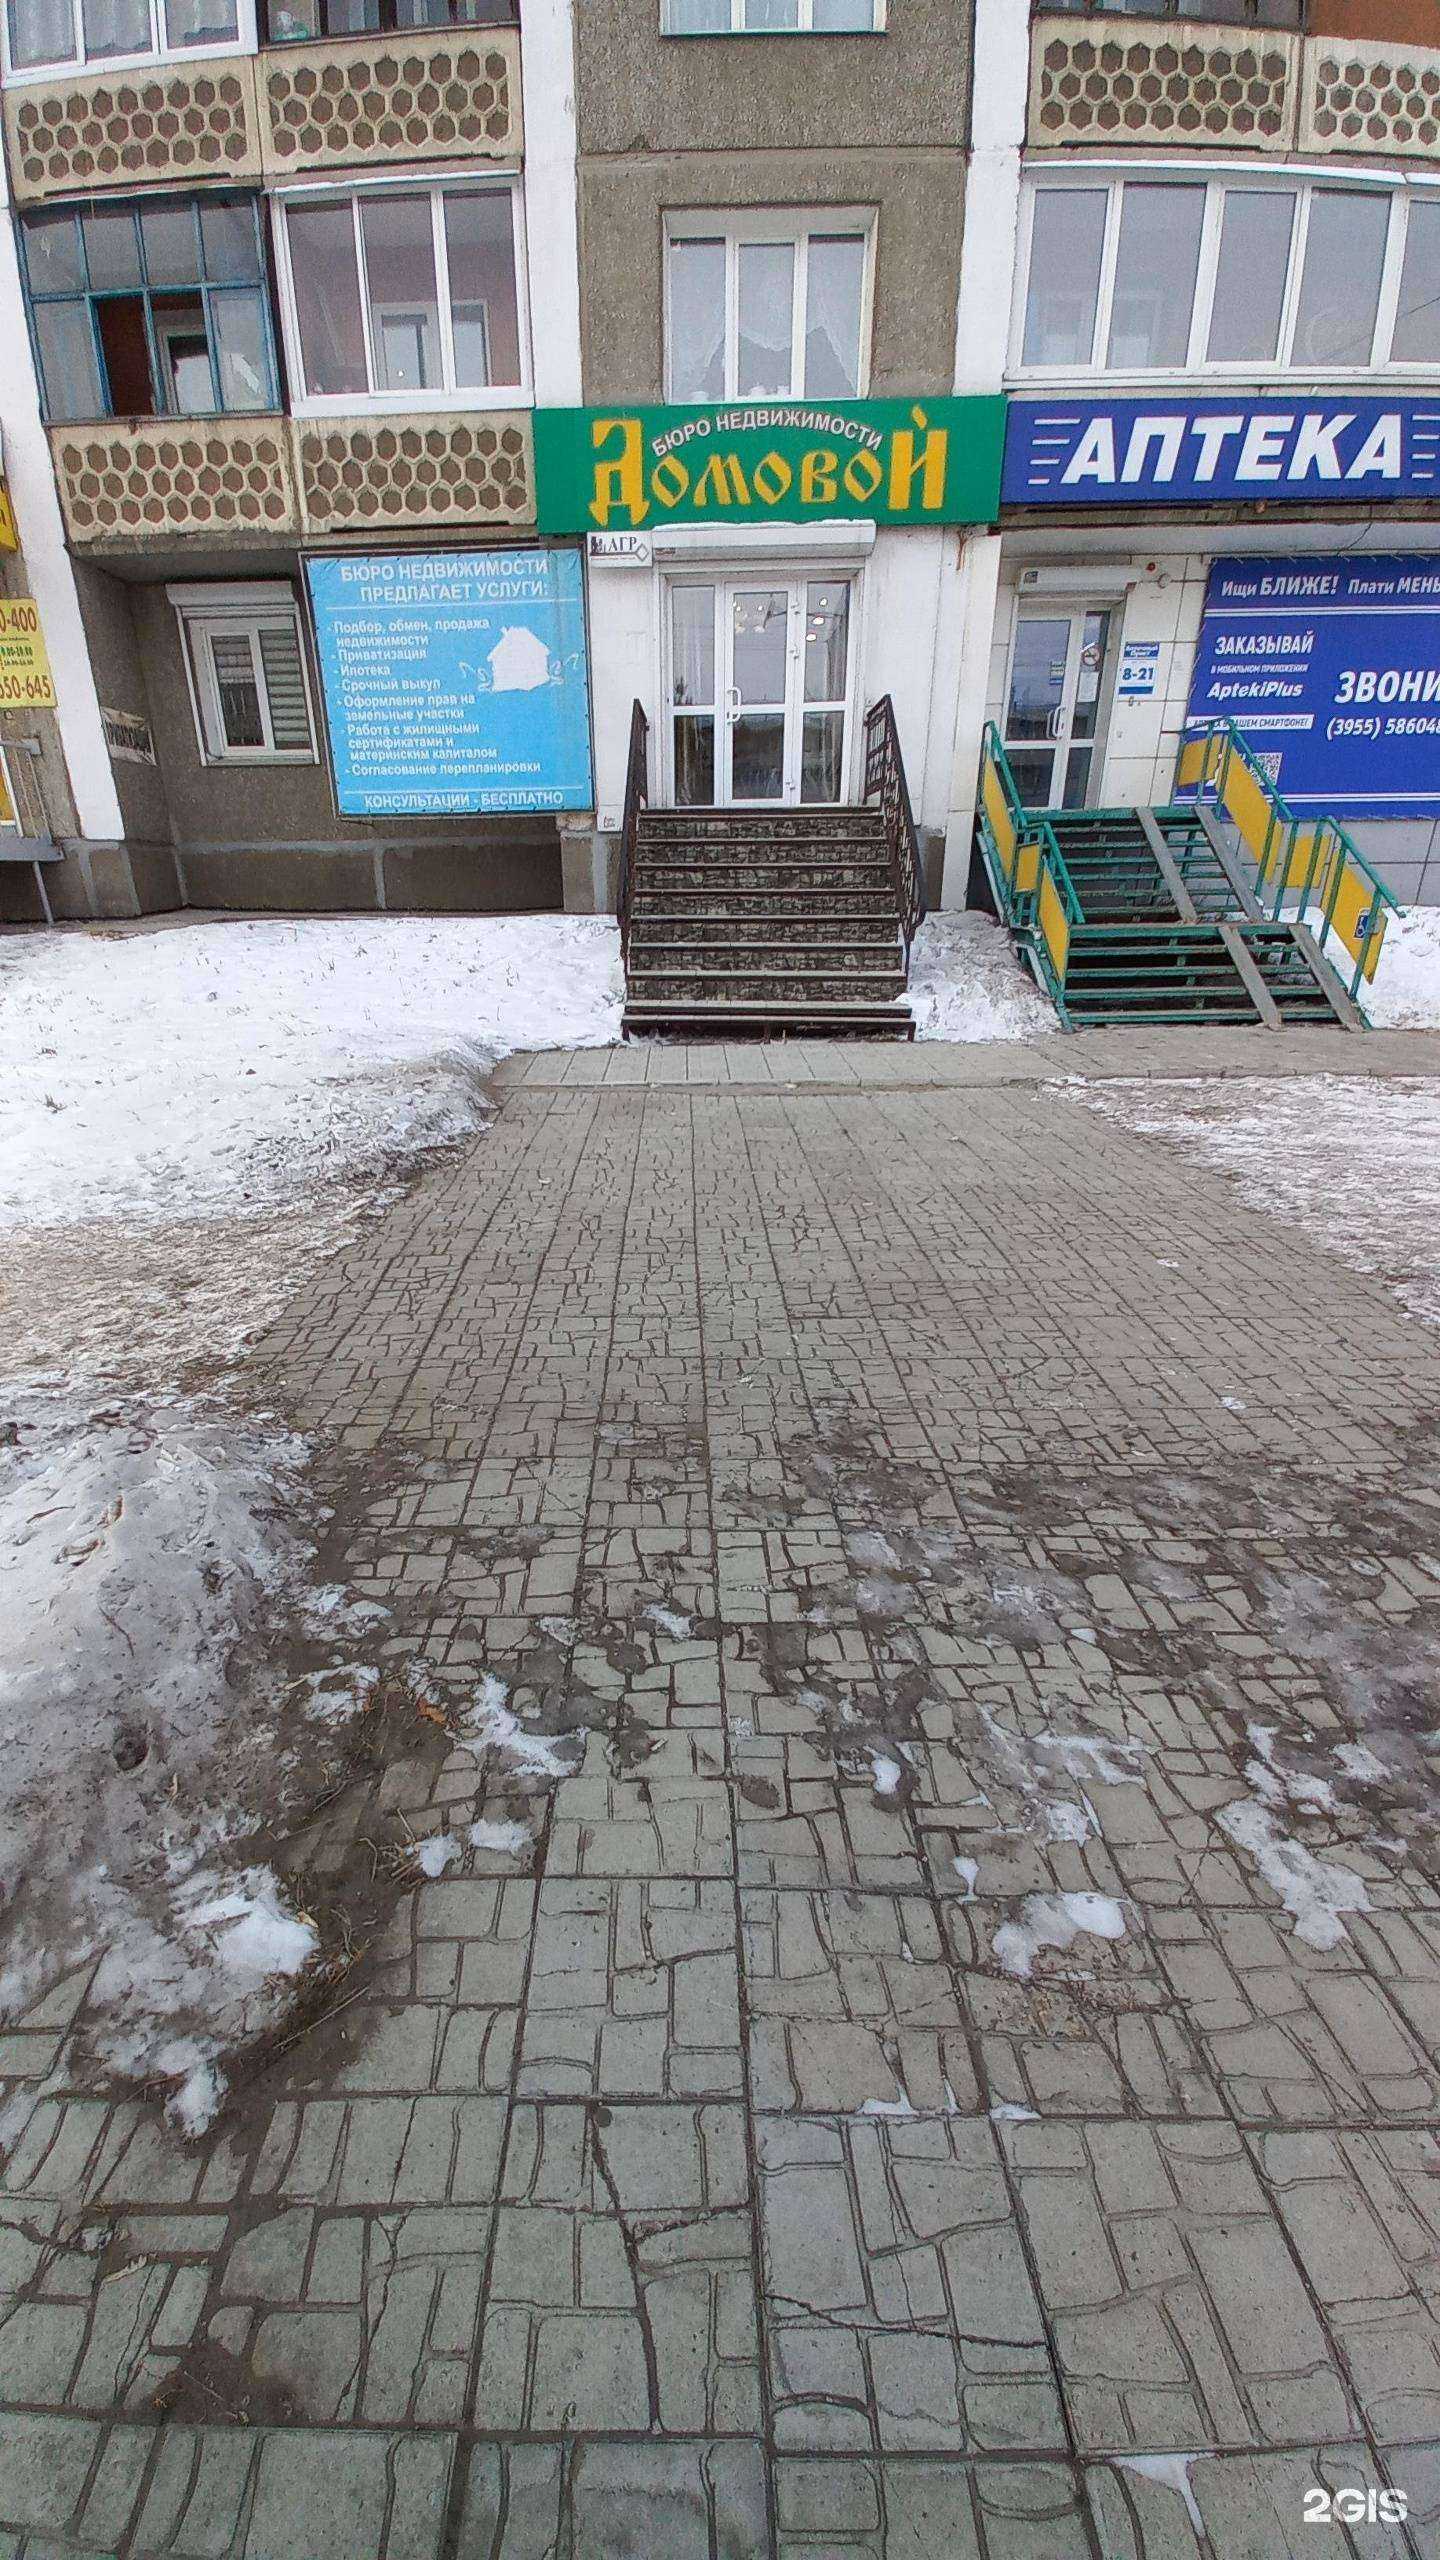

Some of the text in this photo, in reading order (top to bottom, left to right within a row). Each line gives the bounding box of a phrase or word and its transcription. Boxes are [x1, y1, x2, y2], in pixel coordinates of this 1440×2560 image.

[652, 407, 884, 458] БЮРО НЕДВИЖИМОСТИ
[1060, 414, 1401, 484] АПТЕКА
[341, 559, 548, 582] БЮРО НЕДВИЖИМОСТИ
[361, 581, 549, 603] ПРЕДЛАГАЕТ УСЛУГИ:
[1221, 581, 1257, 598] Ищи
[1259, 575, 1339, 596] БЛИЖЕ!
[1348, 579, 1399, 594] Плати
[333, 621, 386, 635] Подбор,
[435, 618, 491, 632] продажа
[336, 635, 429, 648] недвижимости
[1214, 630, 1315, 655] ЗАКАЗЫВАЙ
[338, 648, 427, 662] Приватизация
[341, 664, 391, 676] Ипотека
[1122, 667, 1154, 680] 8-21
[1217, 664, 1260, 674] МОБИЛЬНОМ
[342, 677, 441, 692] Срочный выкуп
[1206, 681, 1304, 701] AptekiPlus
[343, 693, 476, 710] Оформление прав на
[345, 708, 465, 722] земельные участки
[347, 722, 480, 736] Работа с жилищными
[1327, 716, 1381, 741] (3955)
[348, 737, 454, 749] сертификатами и
[350, 748, 498, 762] материнским капиталом
[351, 760, 541, 776] Согласование перепланировки
[364, 793, 470, 809] КОНСУЛЬТАЦИИ
[481, 791, 564, 806] БЕСПЛАТНО
